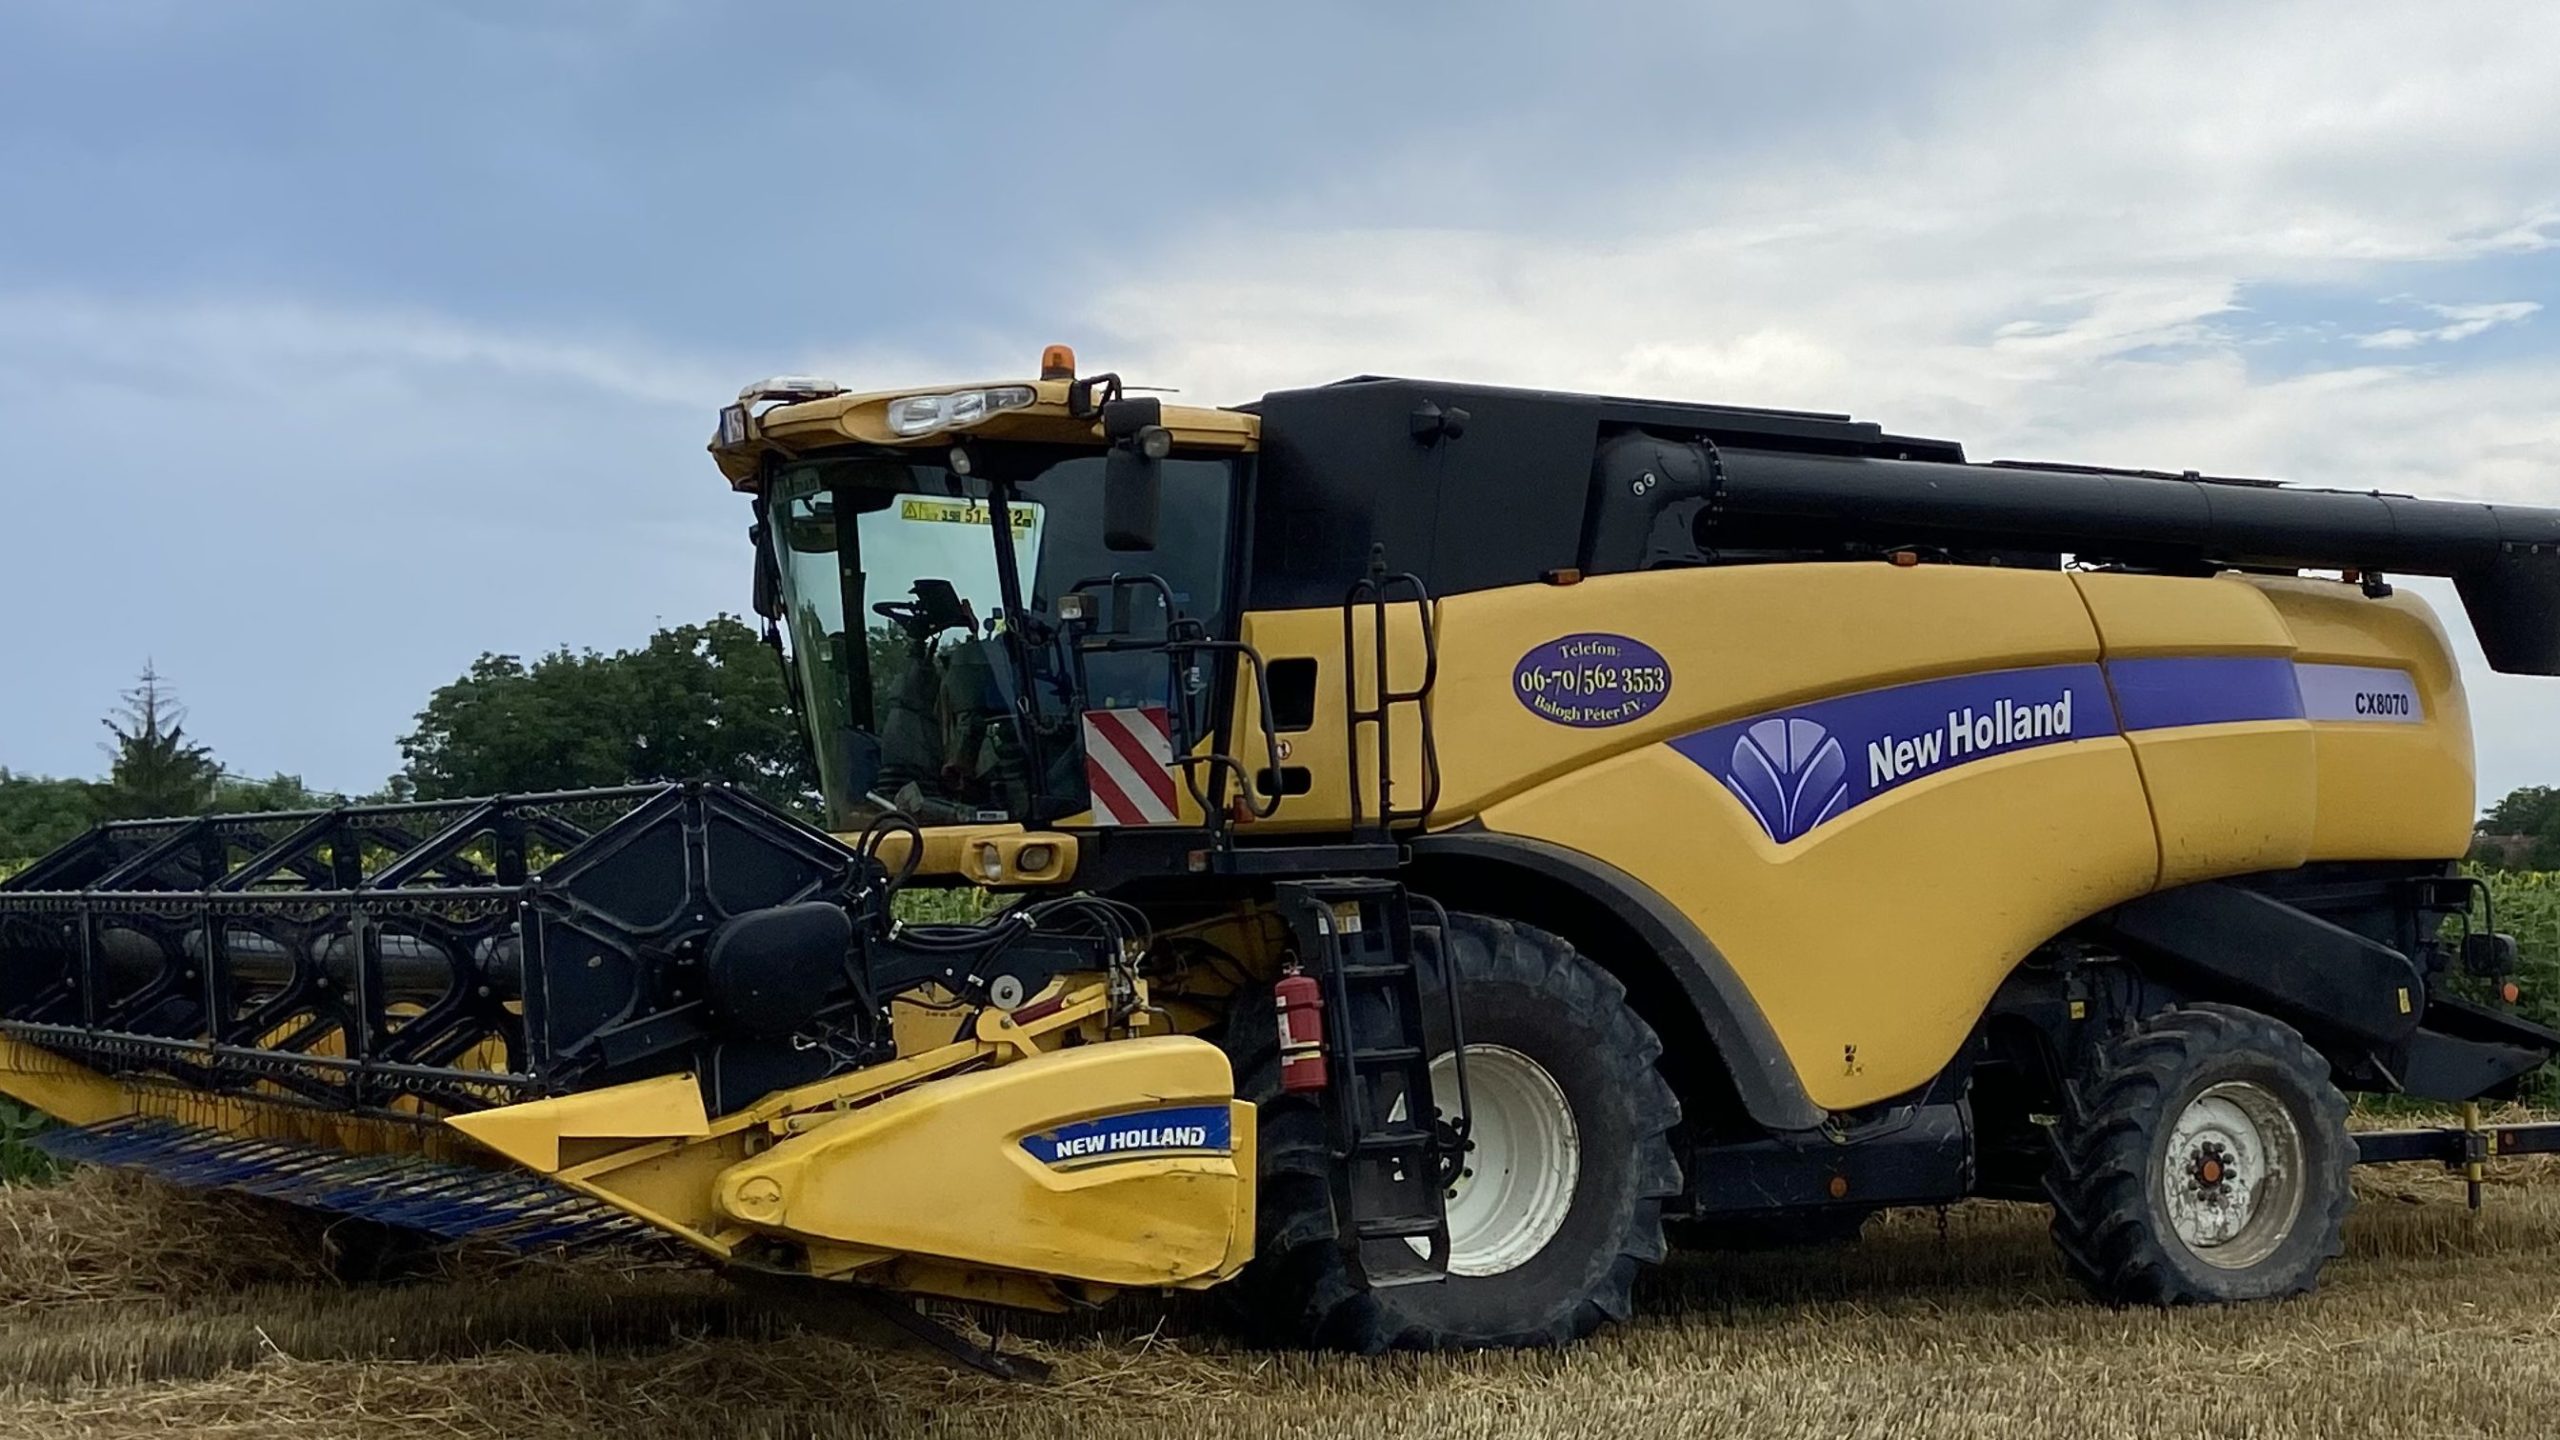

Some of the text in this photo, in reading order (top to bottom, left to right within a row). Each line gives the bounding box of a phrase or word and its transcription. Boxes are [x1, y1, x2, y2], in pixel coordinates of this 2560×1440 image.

[1560, 641, 1622, 659] Telefon:
[1520, 662, 1665, 696] 06-70/562 3553
[1534, 694, 1581, 721] Balogh
[2355, 692, 2409, 715] CX8070
[1868, 689, 2072, 788] New Holland
[1056, 1126, 1206, 1158] NEW HOLLAND
